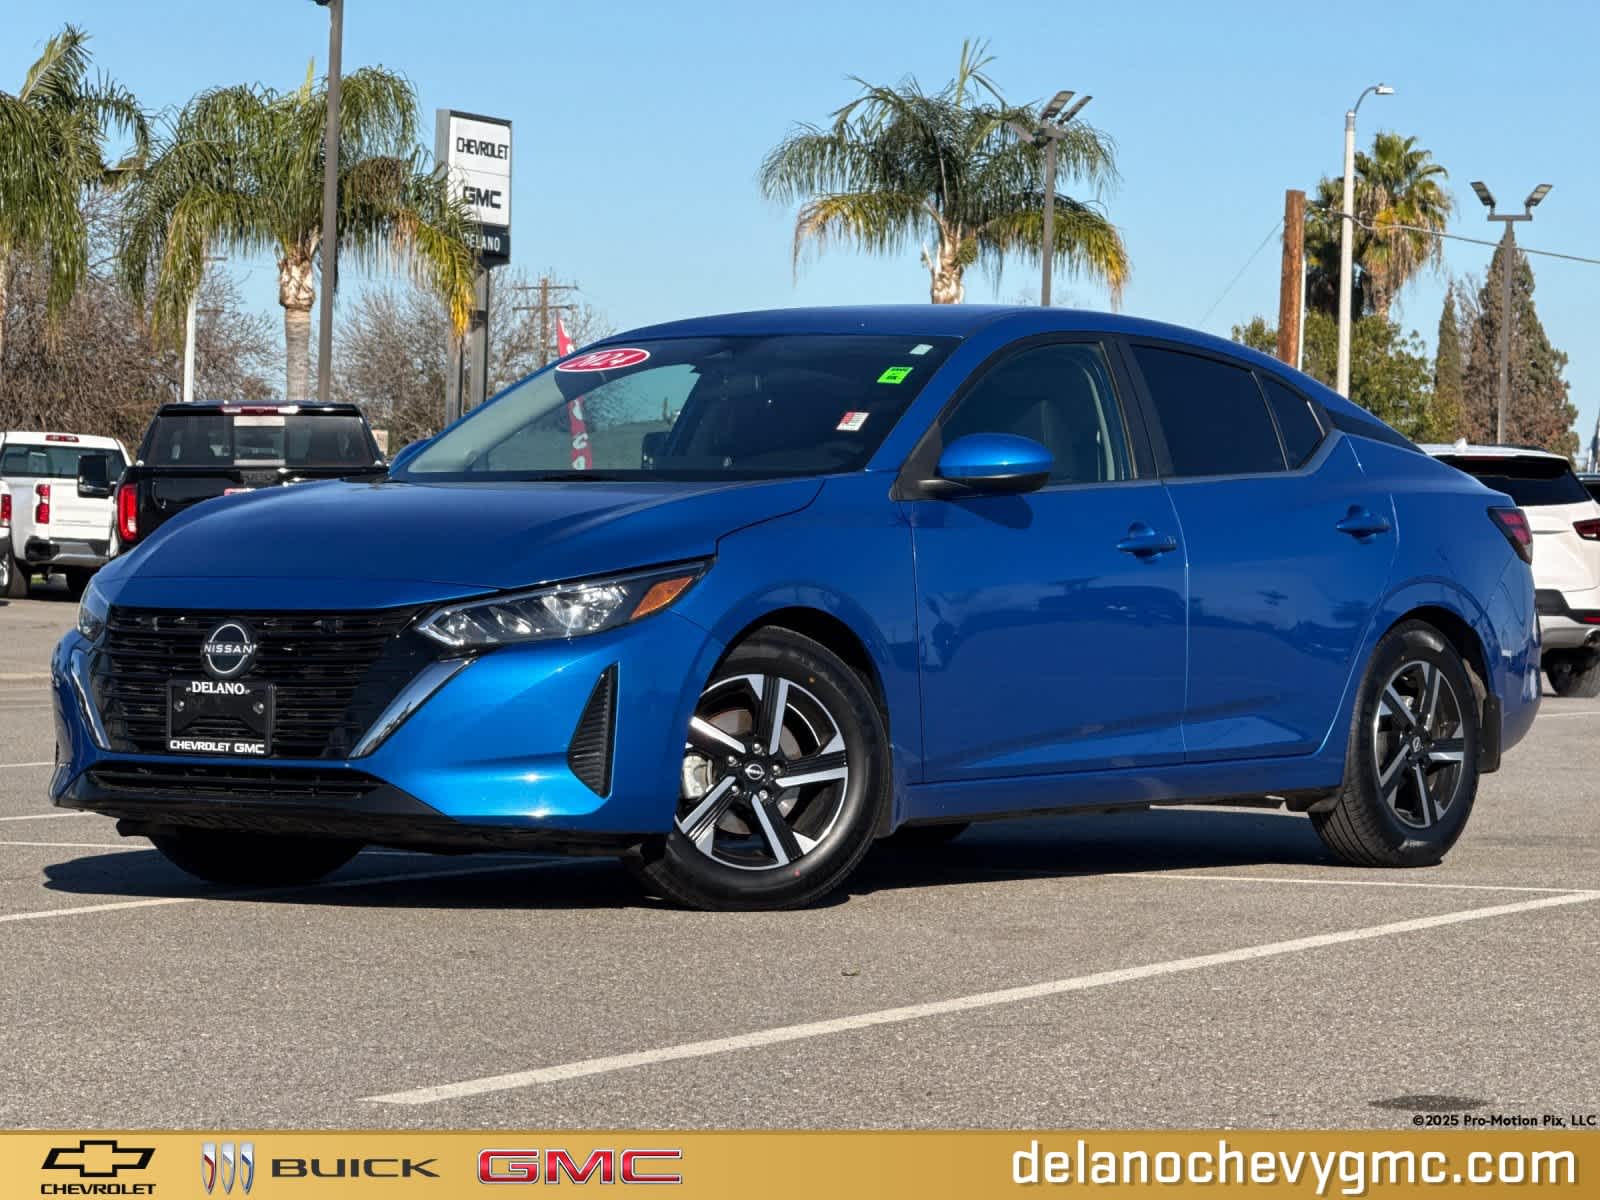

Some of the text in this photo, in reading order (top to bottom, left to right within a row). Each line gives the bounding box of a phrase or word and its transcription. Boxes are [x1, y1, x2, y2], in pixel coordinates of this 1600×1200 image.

[456, 137, 509, 161] CHEVROLET
[463, 186, 502, 209] GMC
[204, 643, 257, 654] NISSAN
[191, 681, 245, 695] DELANO
[169, 740, 265, 754] CHEVROLET GMC
